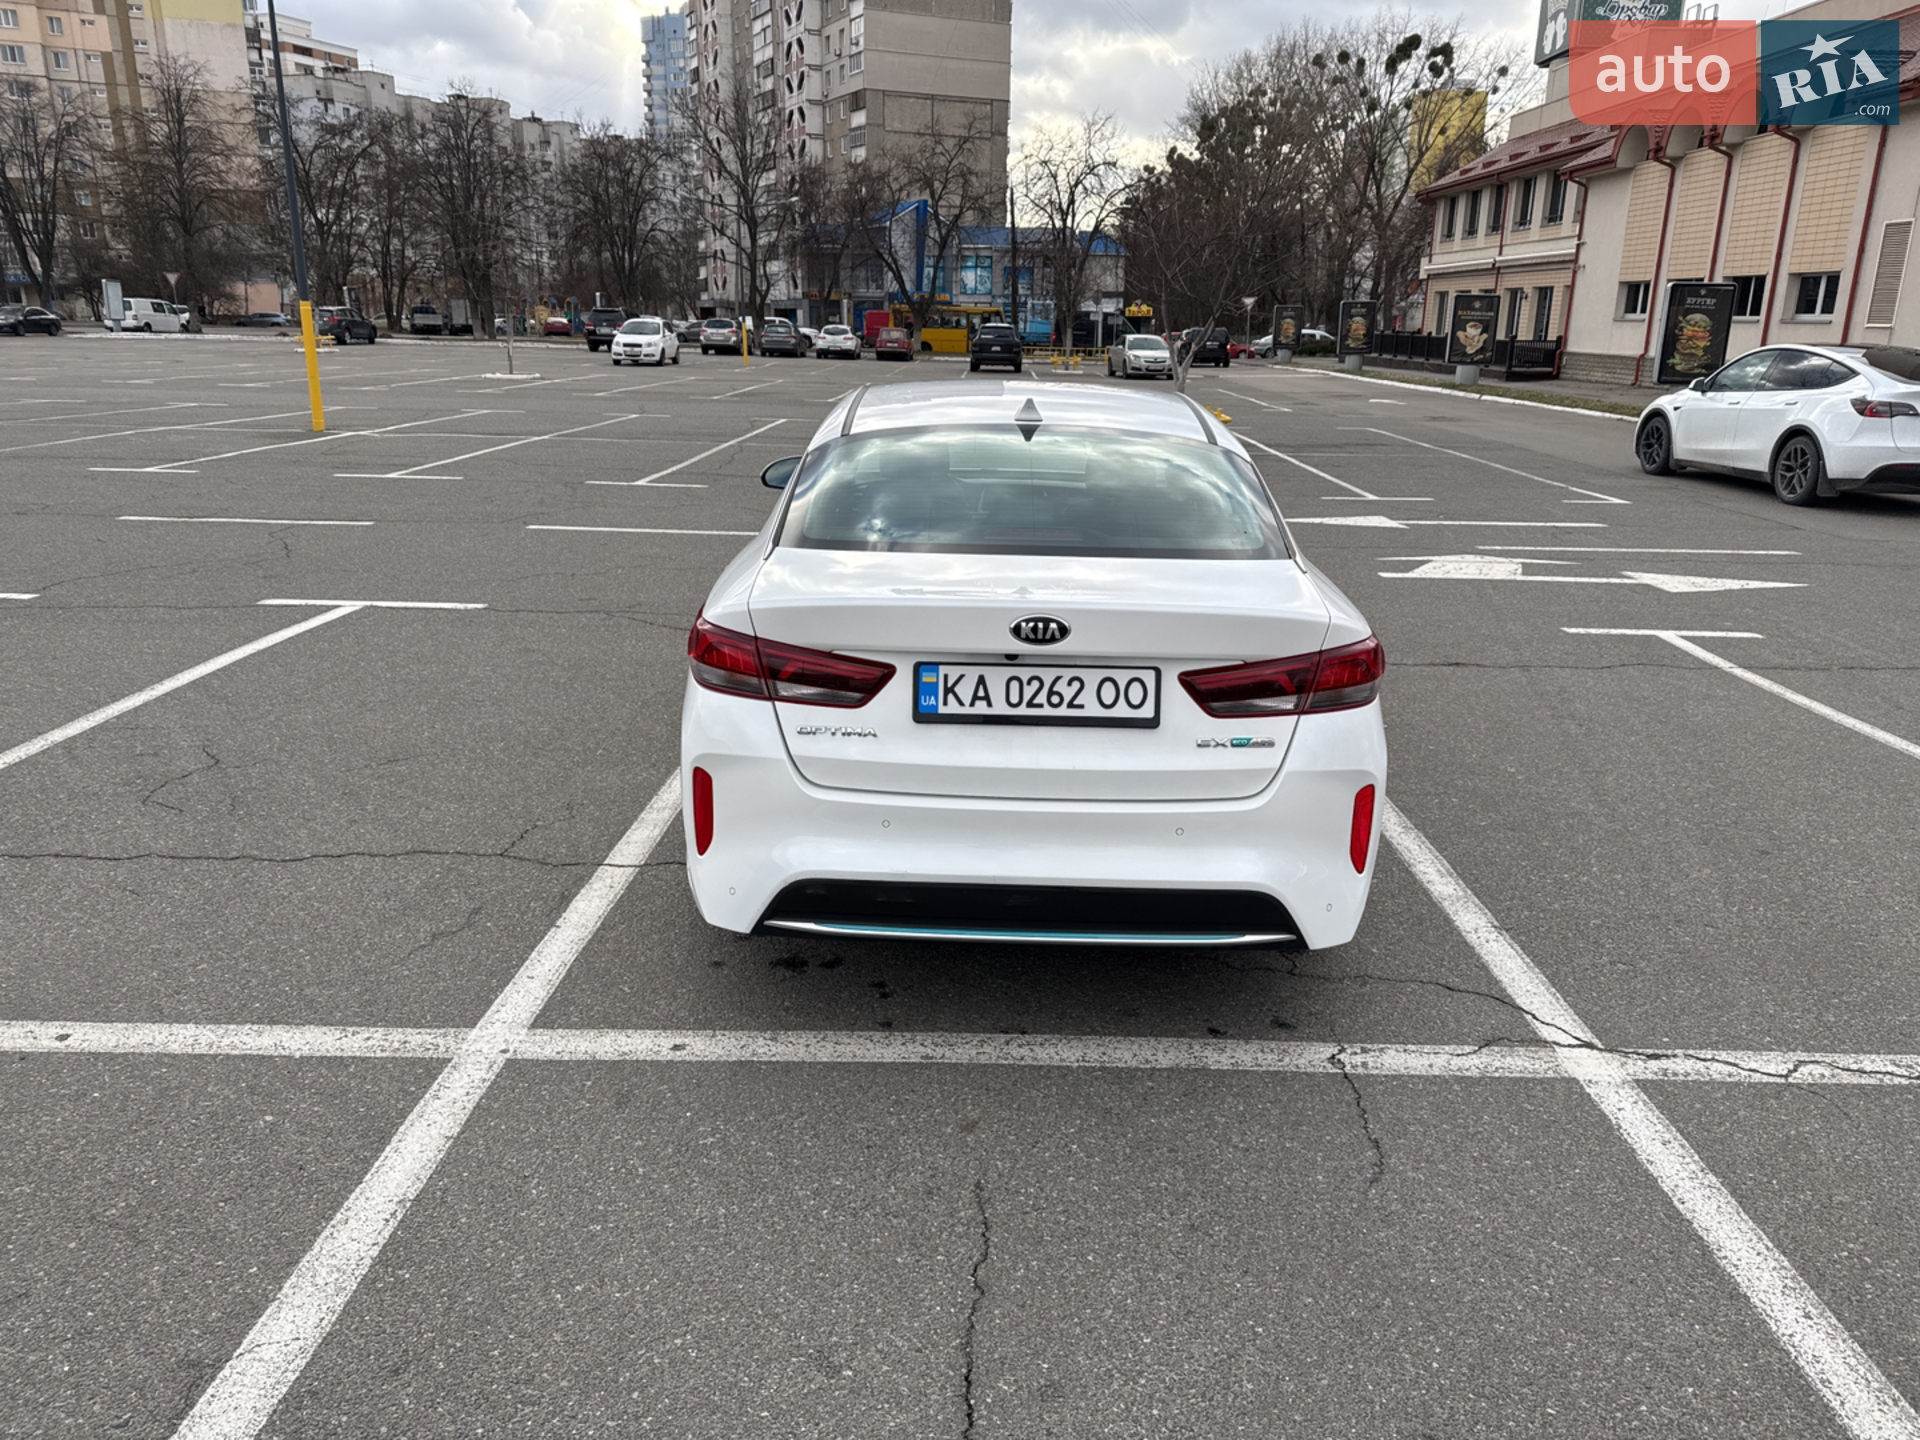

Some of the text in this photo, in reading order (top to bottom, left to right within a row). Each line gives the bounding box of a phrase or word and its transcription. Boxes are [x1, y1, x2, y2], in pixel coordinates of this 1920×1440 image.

[1020, 621, 1061, 640] KIA
[942, 673, 1148, 710] KA 0262 OO
[921, 695, 936, 706] UA
[797, 725, 878, 738] OPTIMA
[1196, 737, 1228, 748] EX
